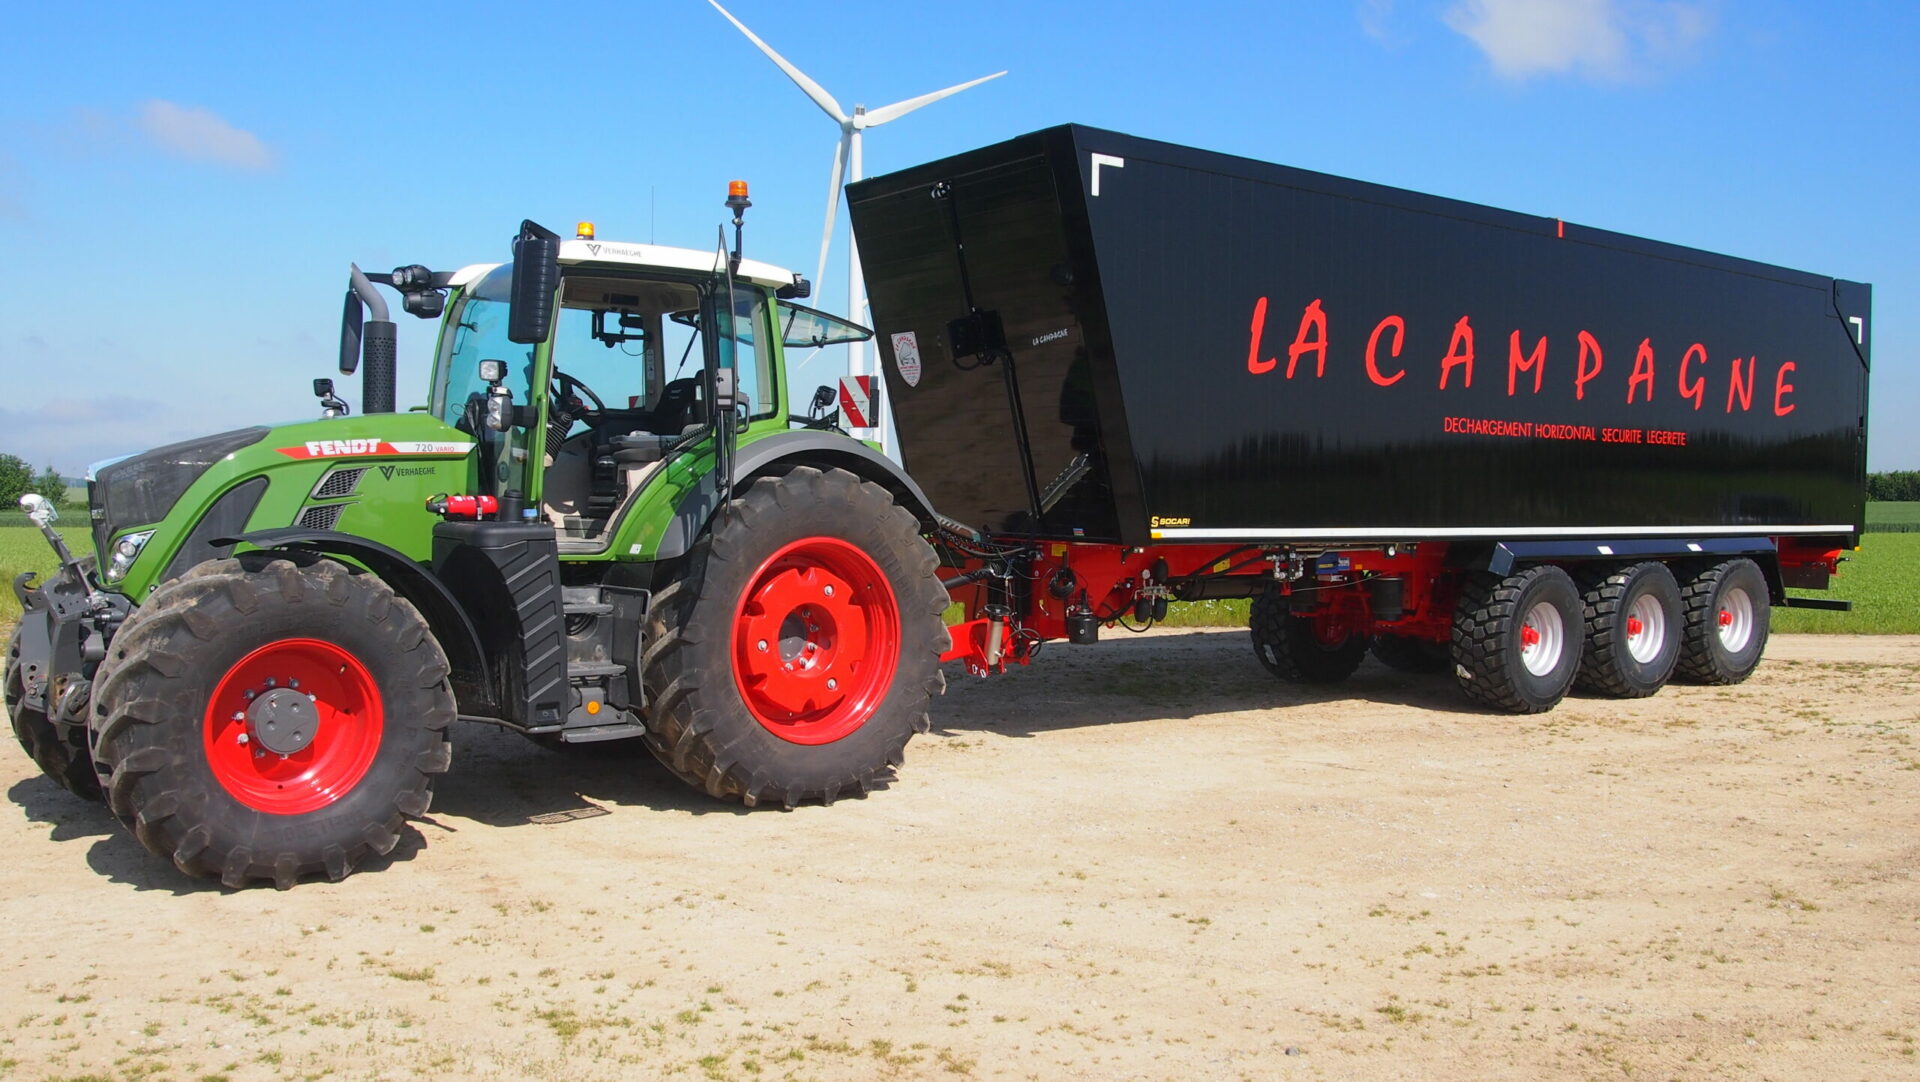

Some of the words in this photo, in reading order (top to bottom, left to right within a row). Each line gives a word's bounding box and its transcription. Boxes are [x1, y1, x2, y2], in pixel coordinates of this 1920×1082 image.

[1248, 297, 1328, 379] LA
[1365, 315, 1796, 416] CAMPAGNE
[1444, 417, 1532, 437] DECHARGEMENT
[1535, 423, 1596, 441] HORIZONTAL
[1602, 428, 1642, 444] SECURITE
[1647, 430, 1687, 446] LEGERETE
[305, 438, 381, 456] FENDT
[415, 443, 433, 452] 720
[396, 466, 436, 477] VERHAEGHE
